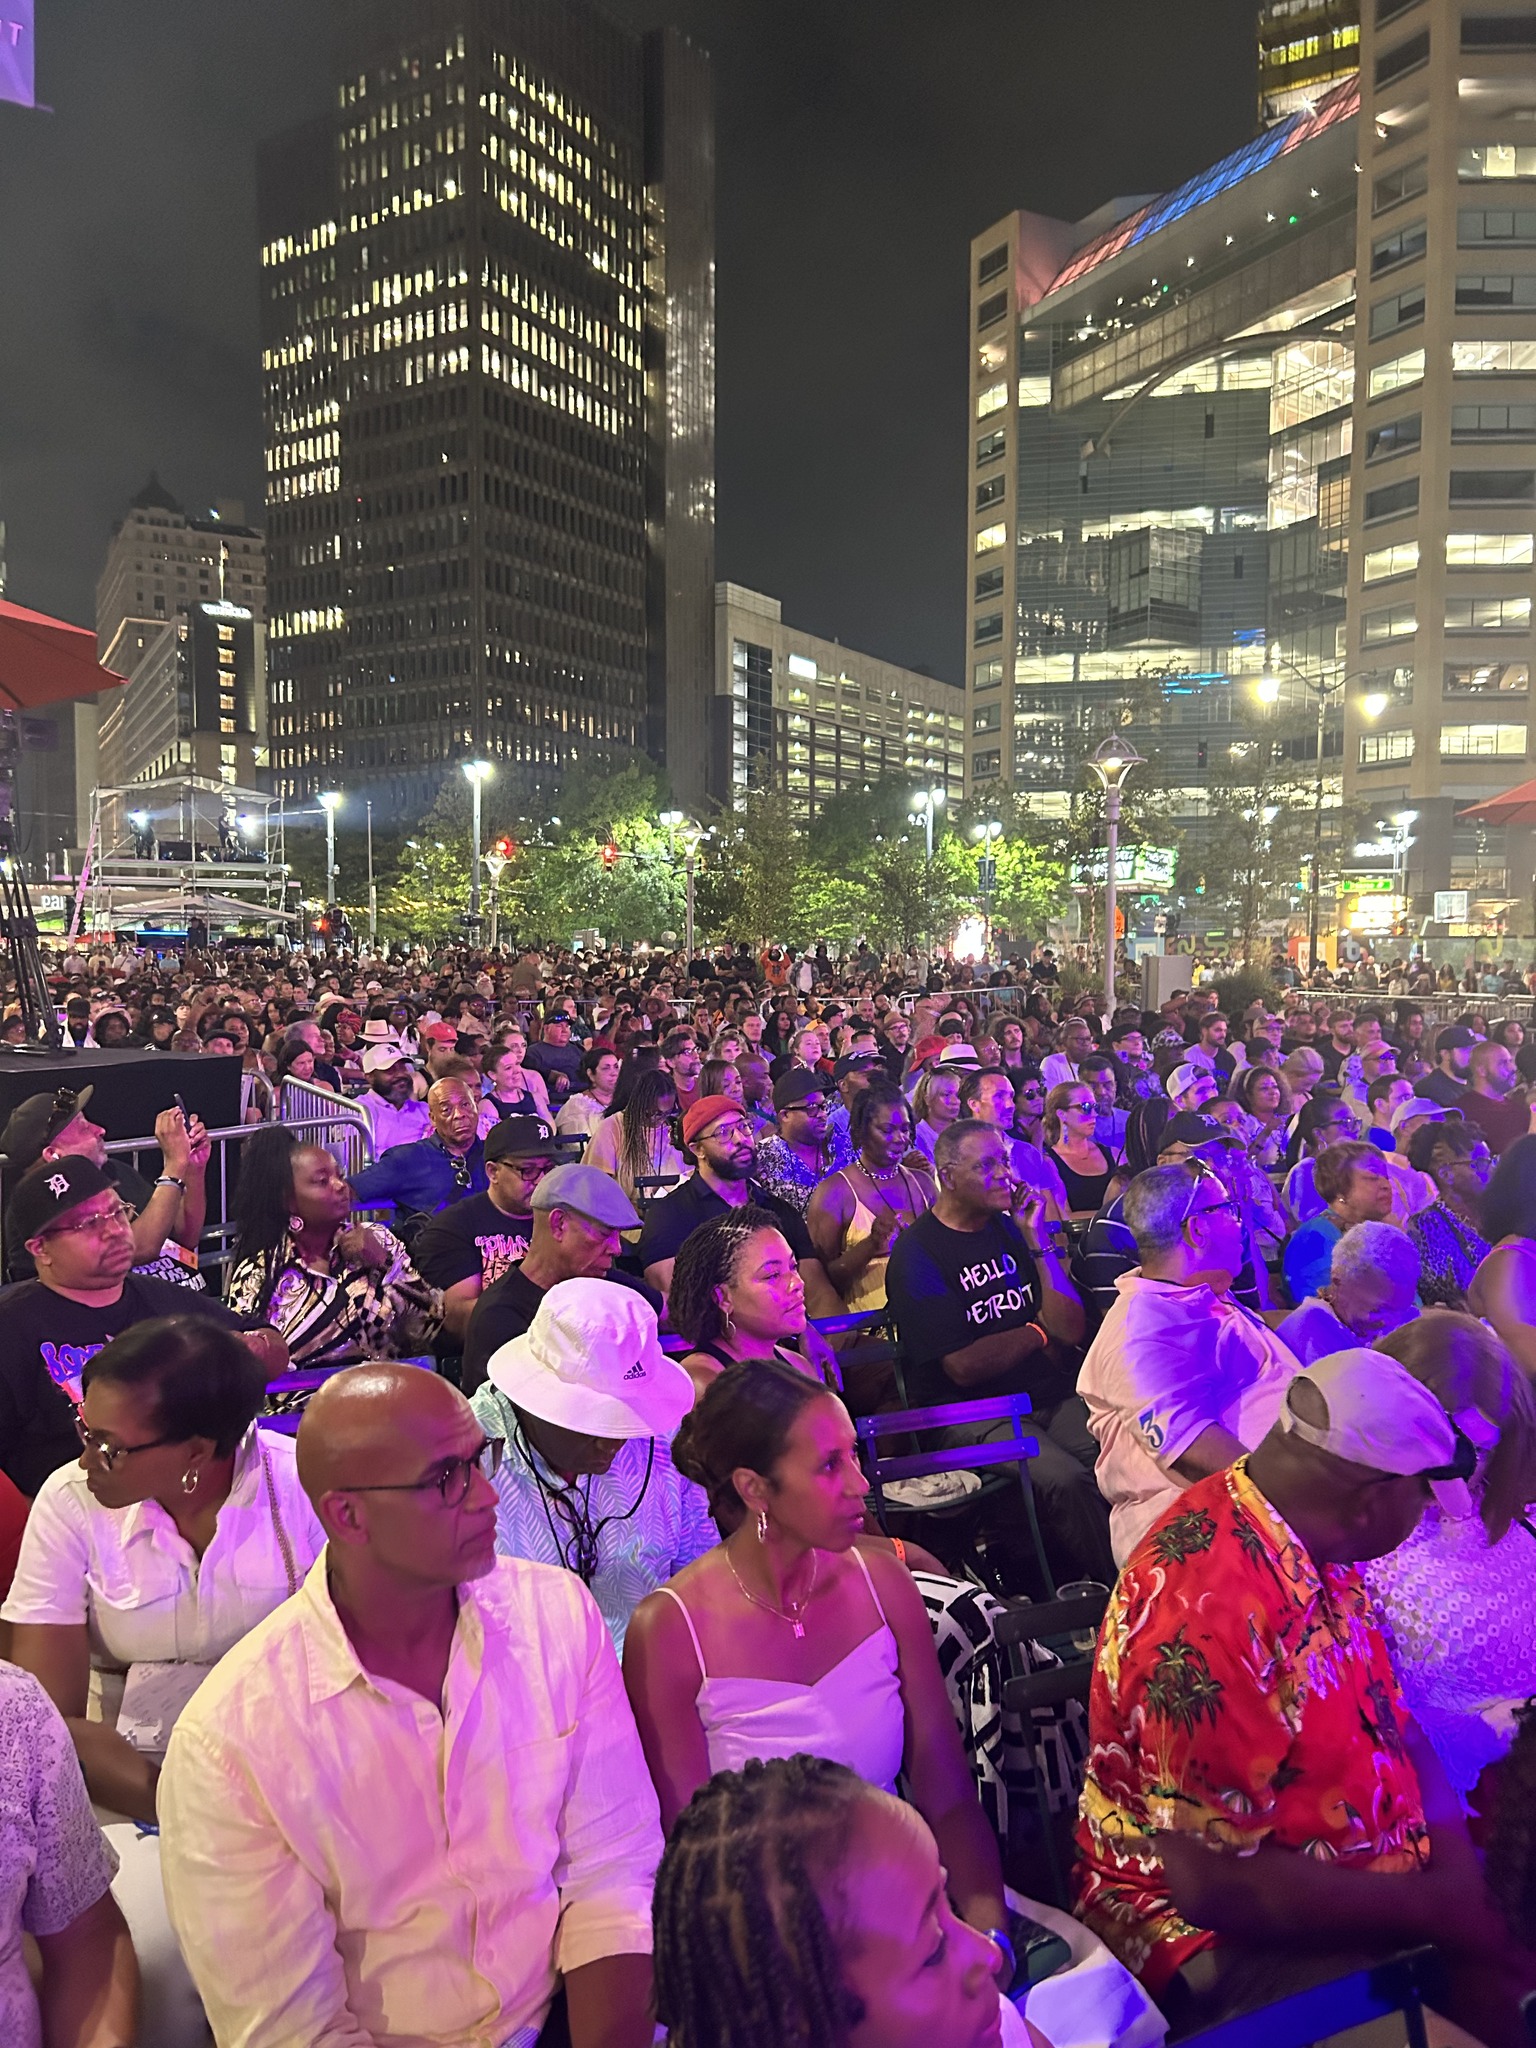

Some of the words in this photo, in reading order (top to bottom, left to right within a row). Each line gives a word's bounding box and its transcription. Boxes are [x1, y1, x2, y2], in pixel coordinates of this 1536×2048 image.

[959, 1253, 1017, 1291] HELLO
[966, 1283, 1034, 1324] ETROIT
[623, 1370, 647, 1380] adidas
